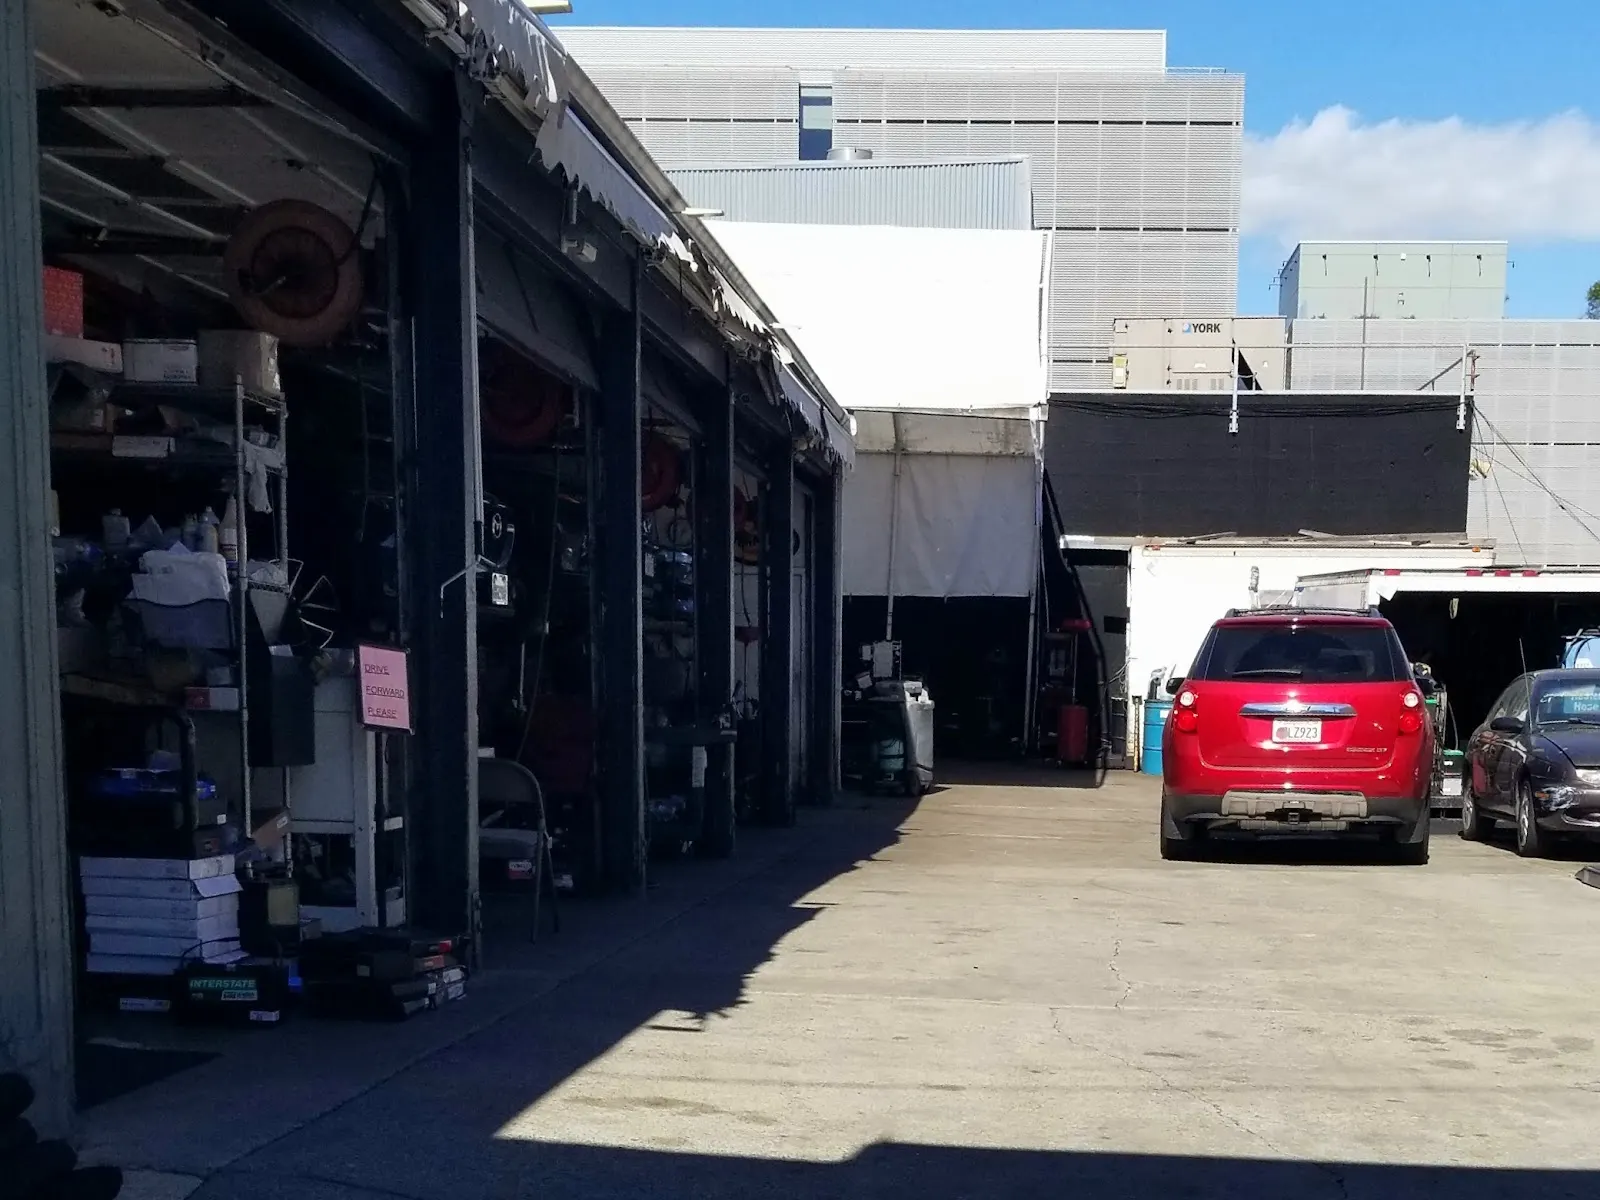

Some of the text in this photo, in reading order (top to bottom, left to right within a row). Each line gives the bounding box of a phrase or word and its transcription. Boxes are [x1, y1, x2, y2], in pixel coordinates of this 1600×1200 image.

[1192, 323, 1221, 333] YORK
[364, 664, 390, 675] DRIVE
[366, 686, 405, 699] FORWARD
[368, 707, 397, 719] PLEASE
[1276, 726, 1318, 739] LZ923
[190, 979, 257, 989] INTERSTATE
